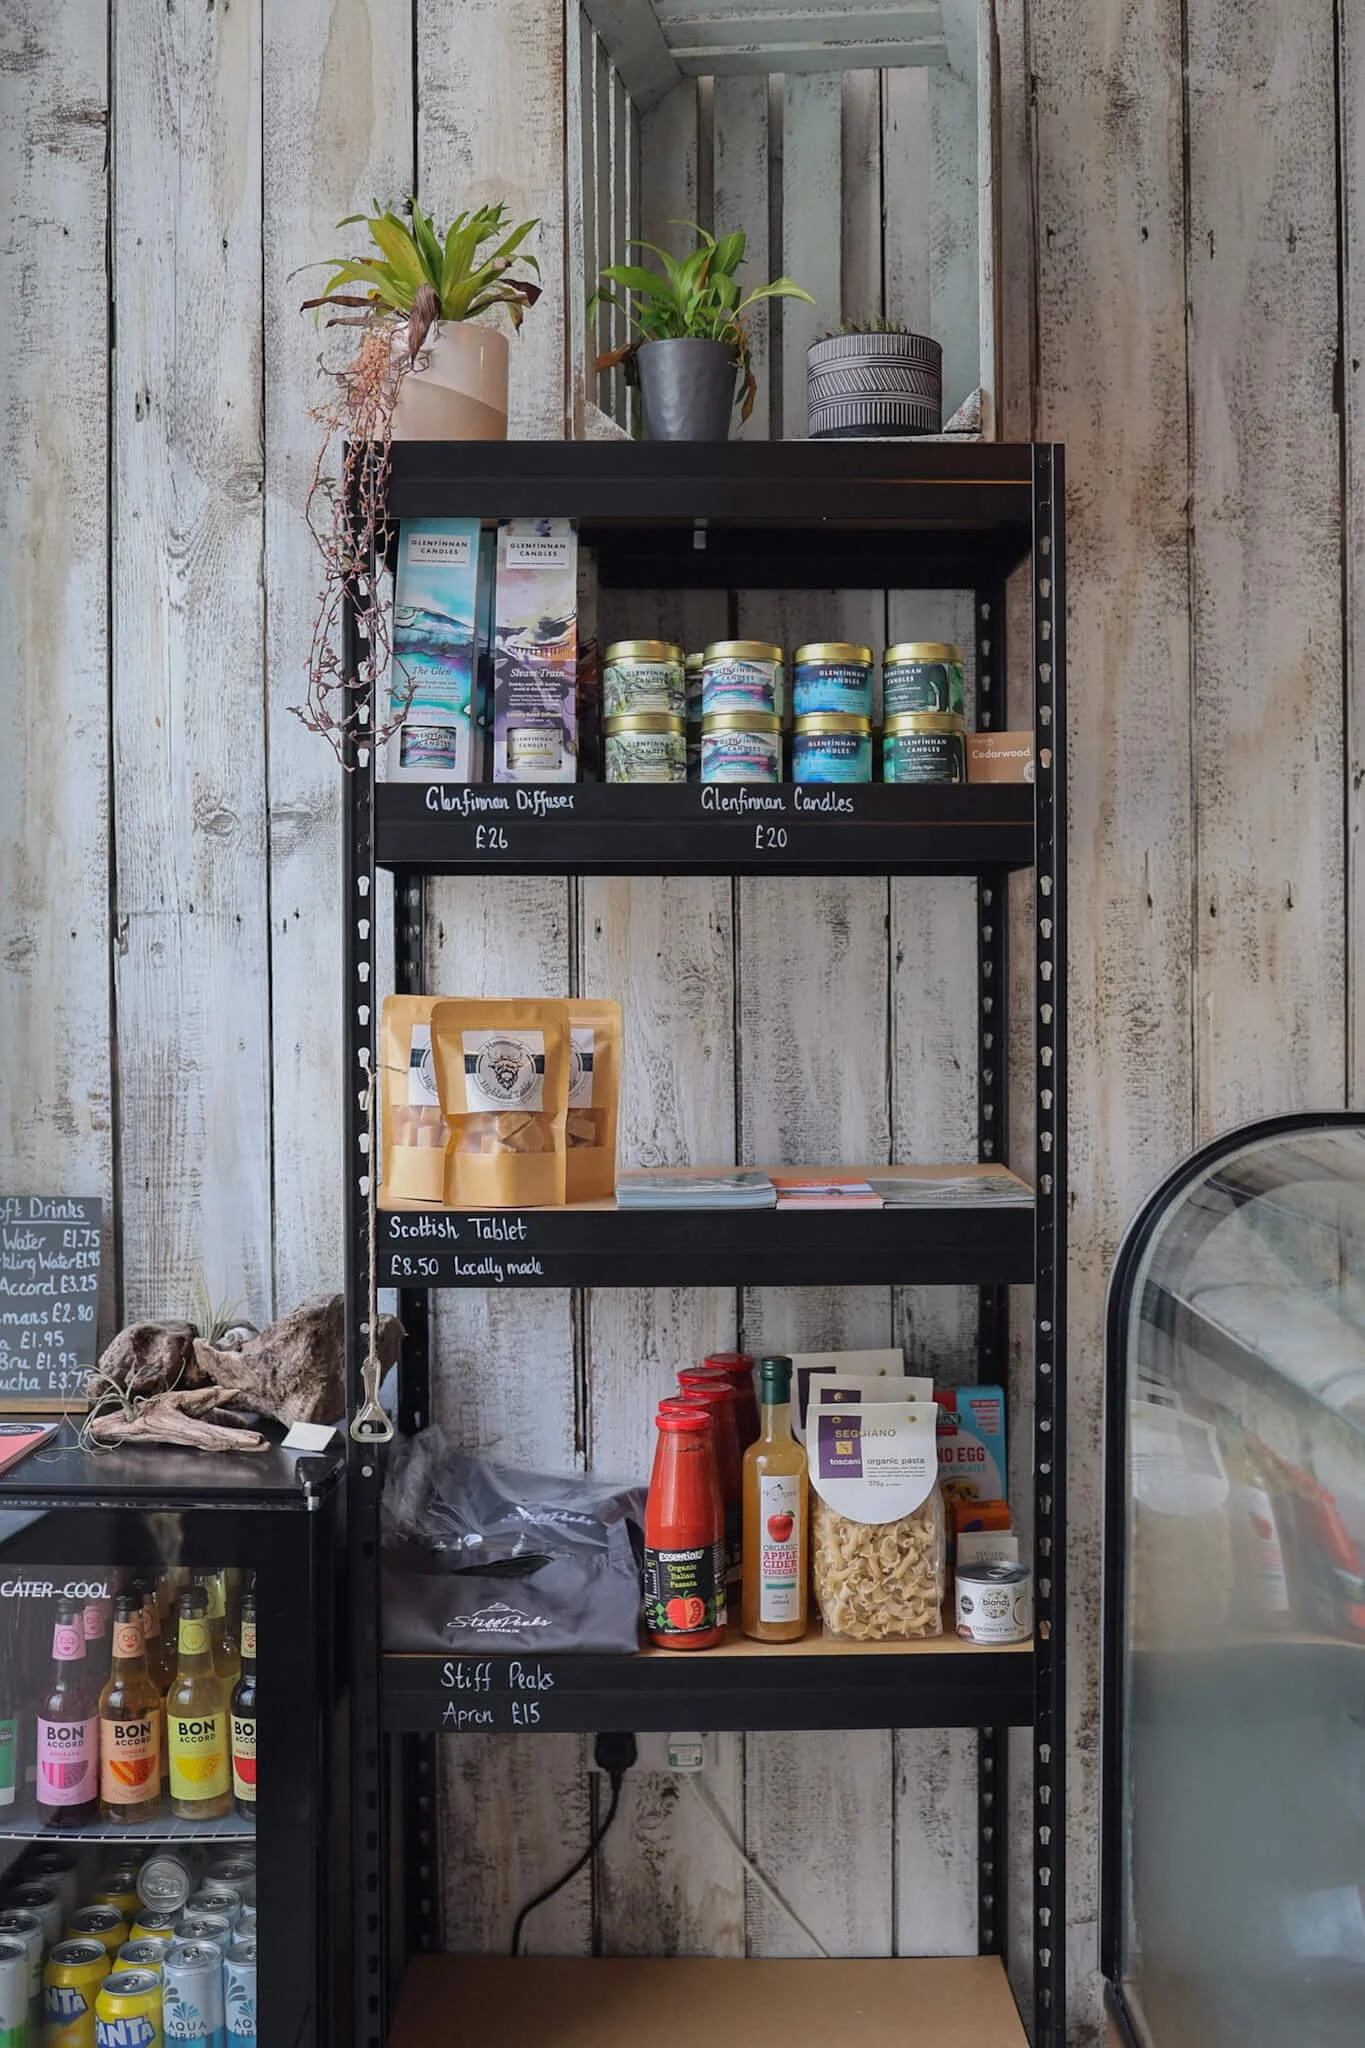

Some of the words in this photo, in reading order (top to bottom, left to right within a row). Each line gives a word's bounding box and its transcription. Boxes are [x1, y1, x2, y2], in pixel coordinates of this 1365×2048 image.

[420, 547, 459, 555] CANDLES
[412, 666, 428, 675] The
[431, 666, 452, 676] Glen
[510, 668, 539, 678] Steam
[540, 668, 565, 677] Train
[887, 675, 914, 685] CANDLES
[972, 747, 1031, 760] Cedarwood
[425, 786, 510, 816] Glenfinnan
[516, 787, 577, 816] Diffuser
[701, 786, 786, 816] Glenfinnan
[794, 787, 855, 813] Candles
[475, 824, 509, 849] £26
[755, 824, 788, 849] £20
[30, 1197, 85, 1219] Drinks
[389, 1215, 460, 1241] Scottish
[467, 1216, 528, 1241] Tablet
[3, 1227, 46, 1250] Water
[63, 1229, 100, 1248] £1.75
[0, 1251, 36, 1280] kling
[38, 1251, 76, 1269] Water
[390, 1254, 440, 1276] £8.50
[507, 1256, 544, 1276] made
[0, 1275, 58, 1295] Accord
[61, 1273, 98, 1293] £3.25
[0, 1311, 48, 1325] mans
[52, 1302, 94, 1323] £2.80
[20, 1330, 65, 1349] £1.95
[36, 1351, 78, 1369] £1.95
[48, 1369, 93, 1389] £3.75
[835, 1429, 896, 1438] SEGGIANO
[830, 1457, 862, 1466] toscani
[867, 1457, 899, 1466] organic
[901, 1457, 925, 1466] pasta
[957, 1447, 985, 1462] EGG
[763, 1544, 798, 1552] ORGANIC
[763, 1551, 798, 1560] APPLE
[667, 1563, 697, 1573] Organic
[763, 1560, 798, 1569] CIDER
[763, 1568, 798, 1576] VINEGAR
[671, 1572, 696, 1580] Italian
[0, 1580, 111, 1598] CATER-COOL
[983, 1598, 1007, 1606] biona
[440, 1662, 492, 1691] Stiff
[509, 1662, 554, 1691] Peaks
[442, 1701, 494, 1729] Apron
[512, 1701, 541, 1724] £15
[47, 1726, 84, 1740] BON
[115, 1721, 152, 1738] BON
[178, 1719, 215, 1735] BON
[235, 1721, 254, 1736] BO
[47, 1740, 84, 1748] ACCORD
[115, 1736, 151, 1746] ACCORD
[180, 1733, 216, 1743] ACCORD
[46, 1987, 87, 2015] NTA
[168, 2020, 207, 2031] AQUA
[234, 2018, 253, 2029] AQ
